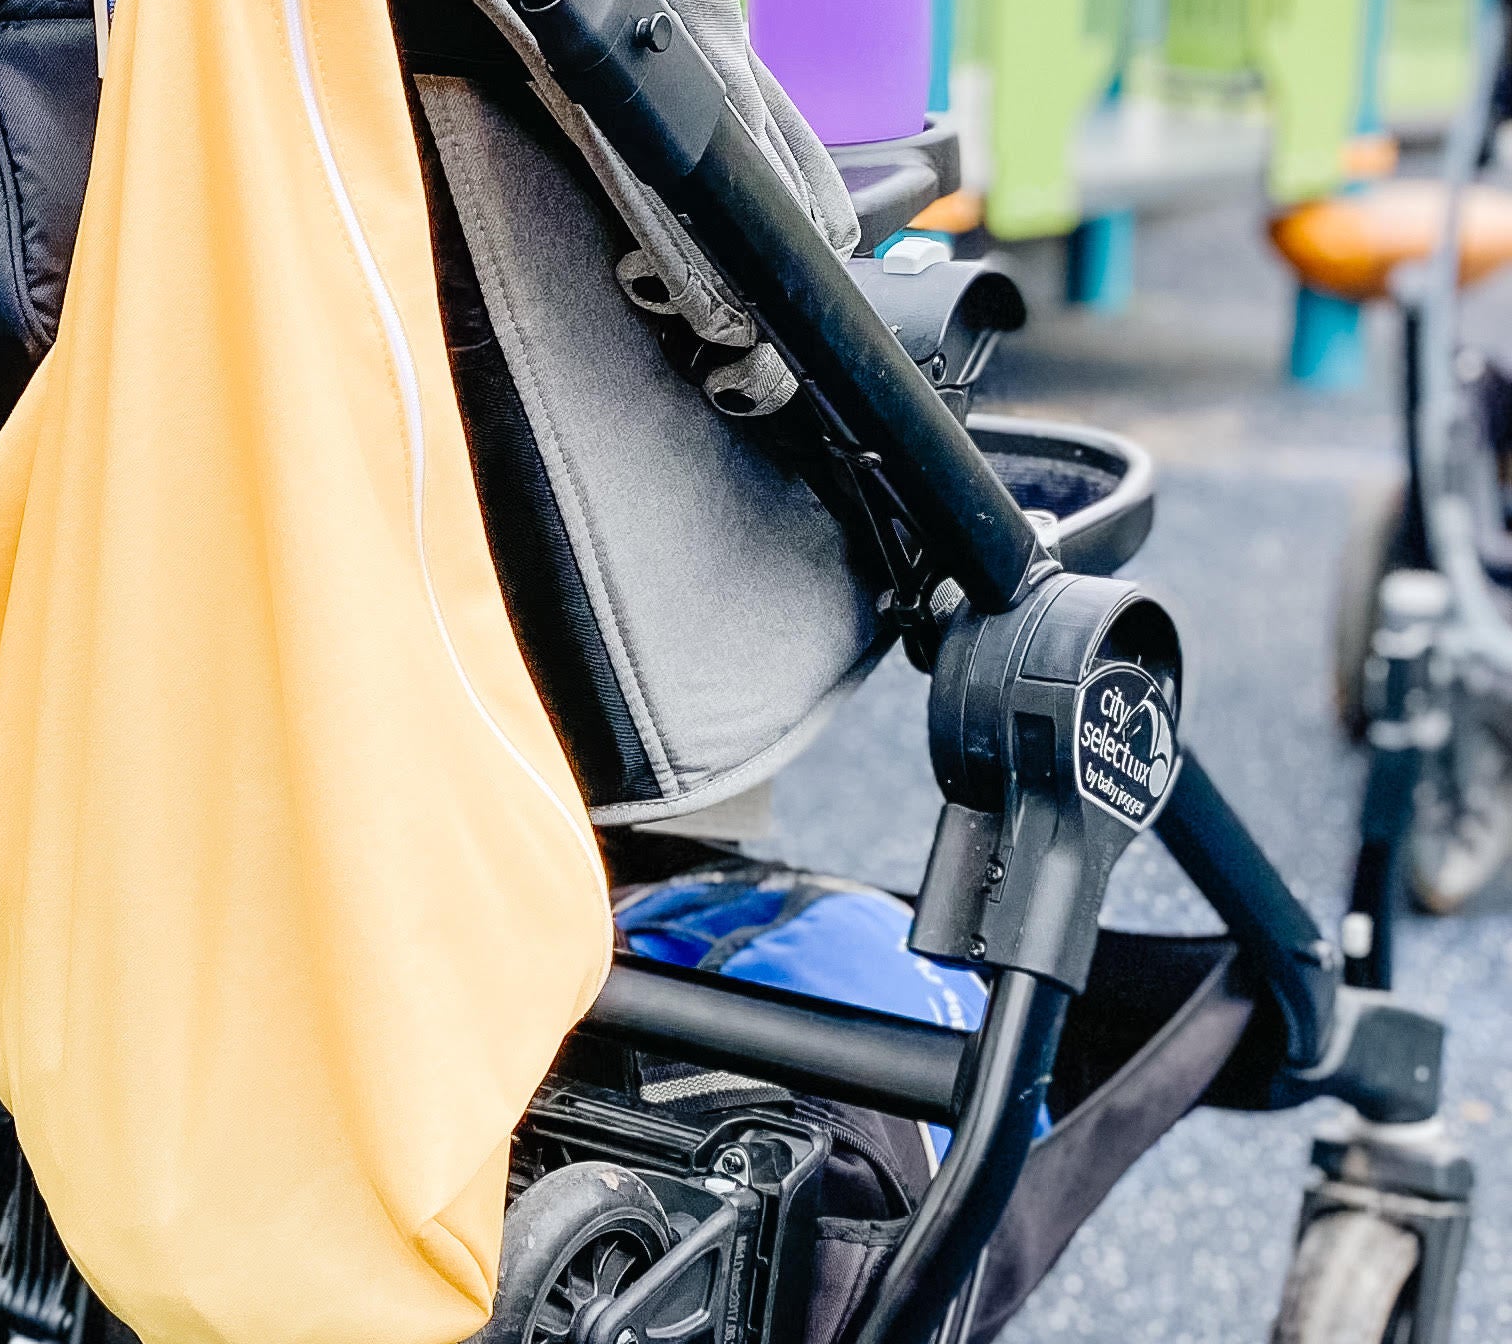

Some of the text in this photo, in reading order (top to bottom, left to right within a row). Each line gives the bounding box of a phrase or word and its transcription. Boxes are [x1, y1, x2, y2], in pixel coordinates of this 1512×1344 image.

[1100, 686, 1131, 734] city
[1085, 761, 1146, 816] by baby jogger
